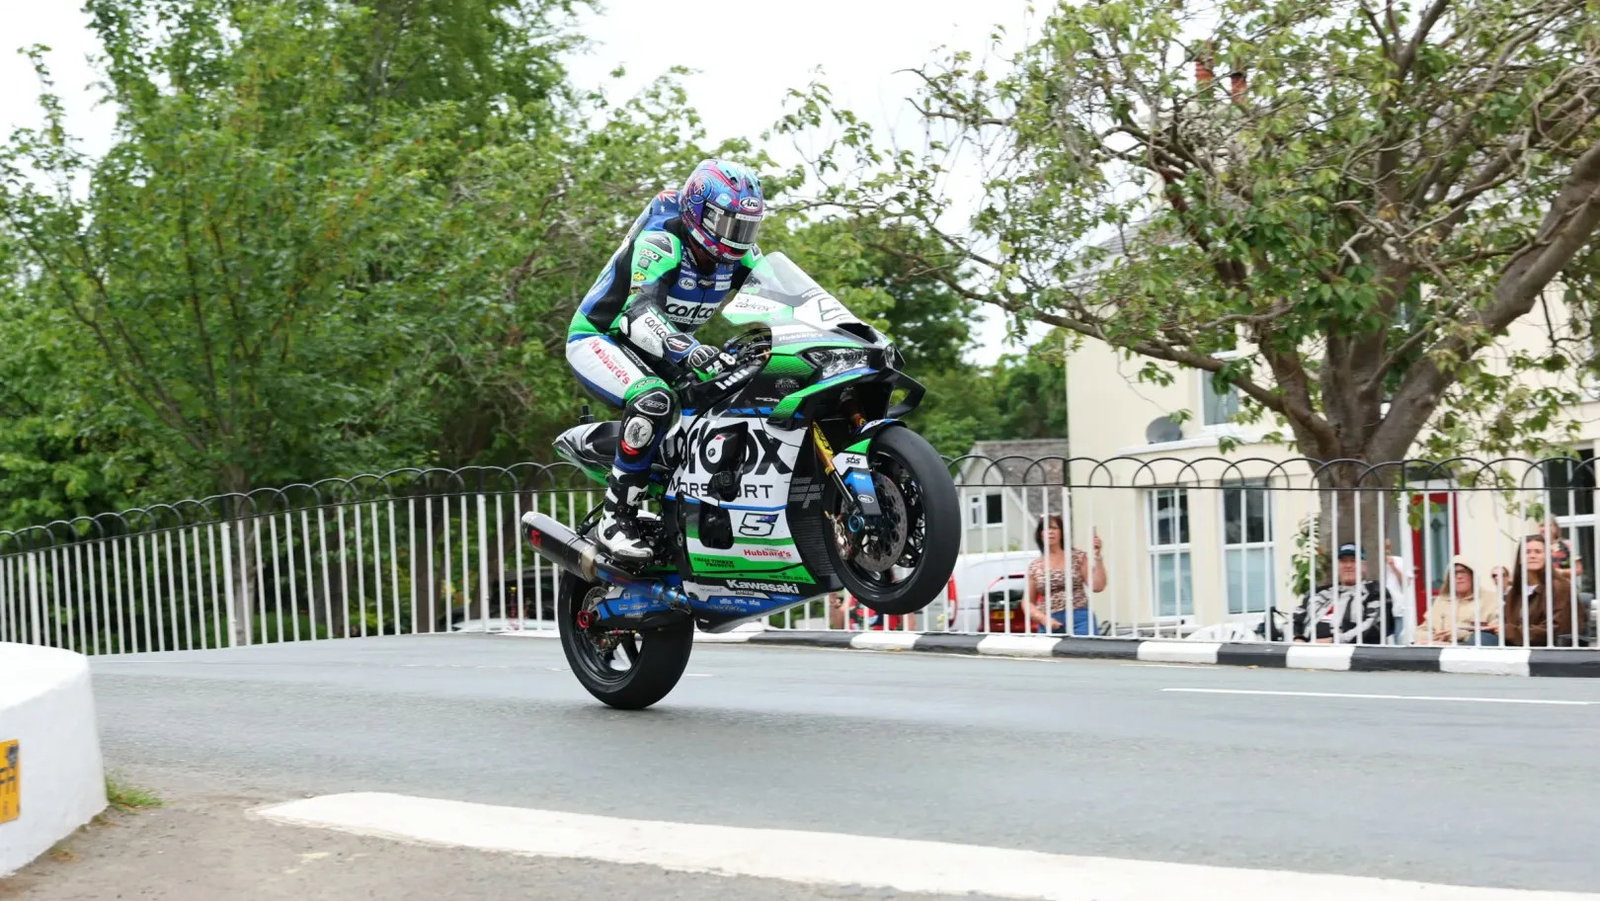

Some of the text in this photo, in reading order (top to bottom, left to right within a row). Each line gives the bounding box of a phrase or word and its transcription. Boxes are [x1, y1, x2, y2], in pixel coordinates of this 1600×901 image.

[589, 338, 632, 386] Hubbard's
[738, 512, 780, 538] 5
[744, 549, 791, 558] Hubbard's
[726, 579, 799, 594] Kawasaki
